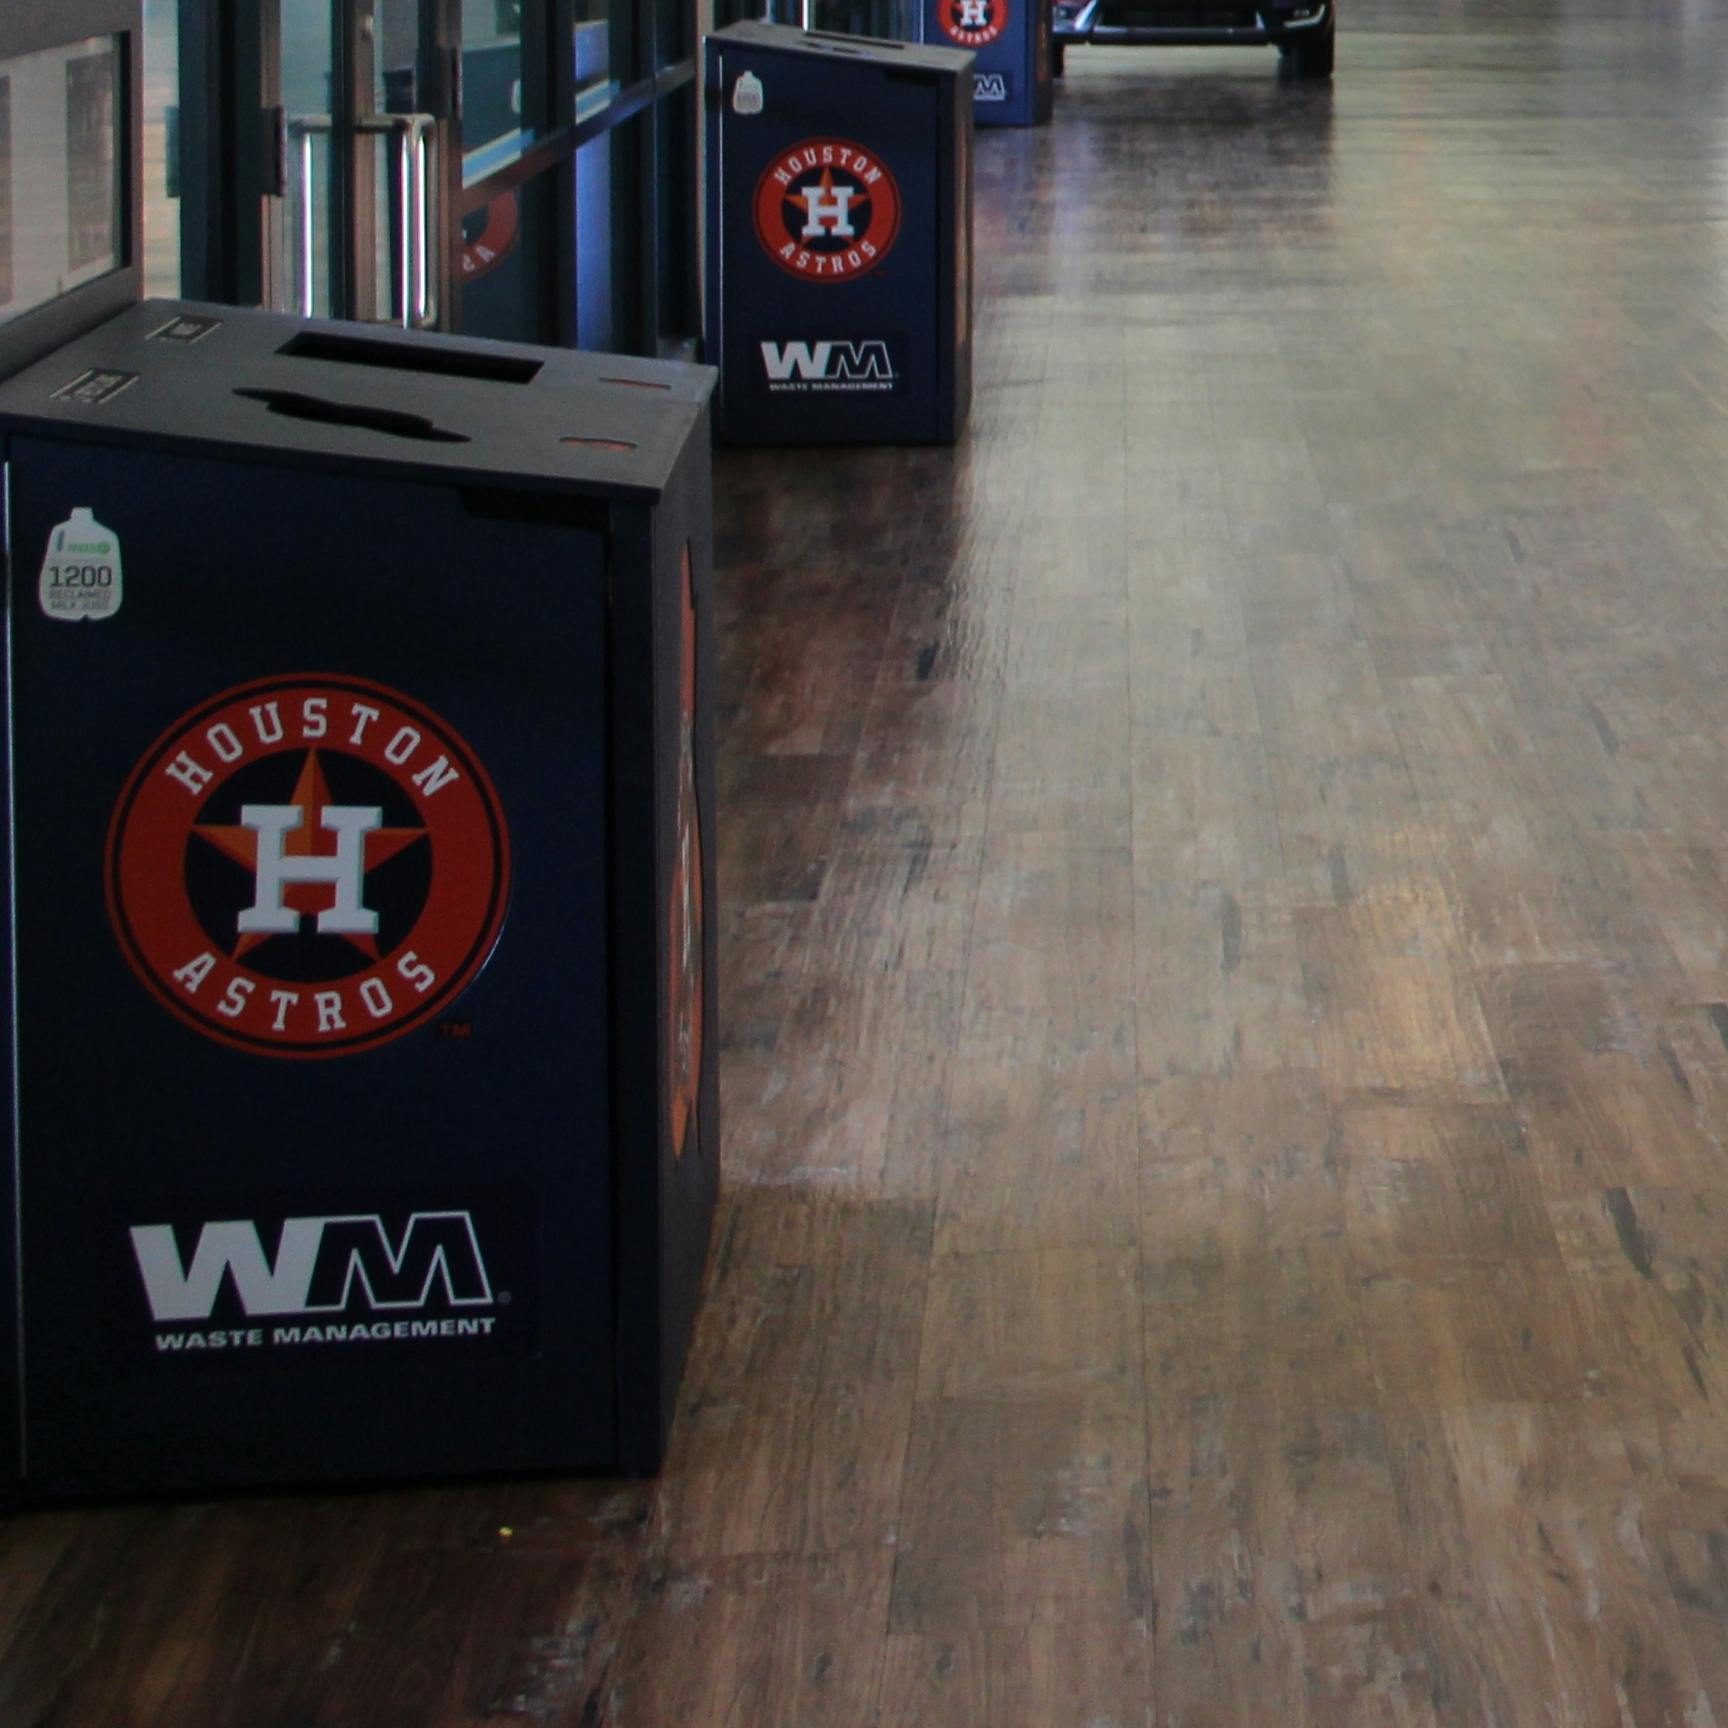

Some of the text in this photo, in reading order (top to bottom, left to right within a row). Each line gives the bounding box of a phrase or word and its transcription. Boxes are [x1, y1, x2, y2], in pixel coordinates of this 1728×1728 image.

[774, 144, 882, 186] HOUSTON
[779, 241, 877, 274] ASTROS
[49, 565, 112, 588] 1200
[165, 698, 460, 797] HOUSTON
[173, 950, 436, 1032] ASTROS
[129, 1210, 494, 1322] WM
[155, 1317, 496, 1351] WASTE MANAGEMENT
